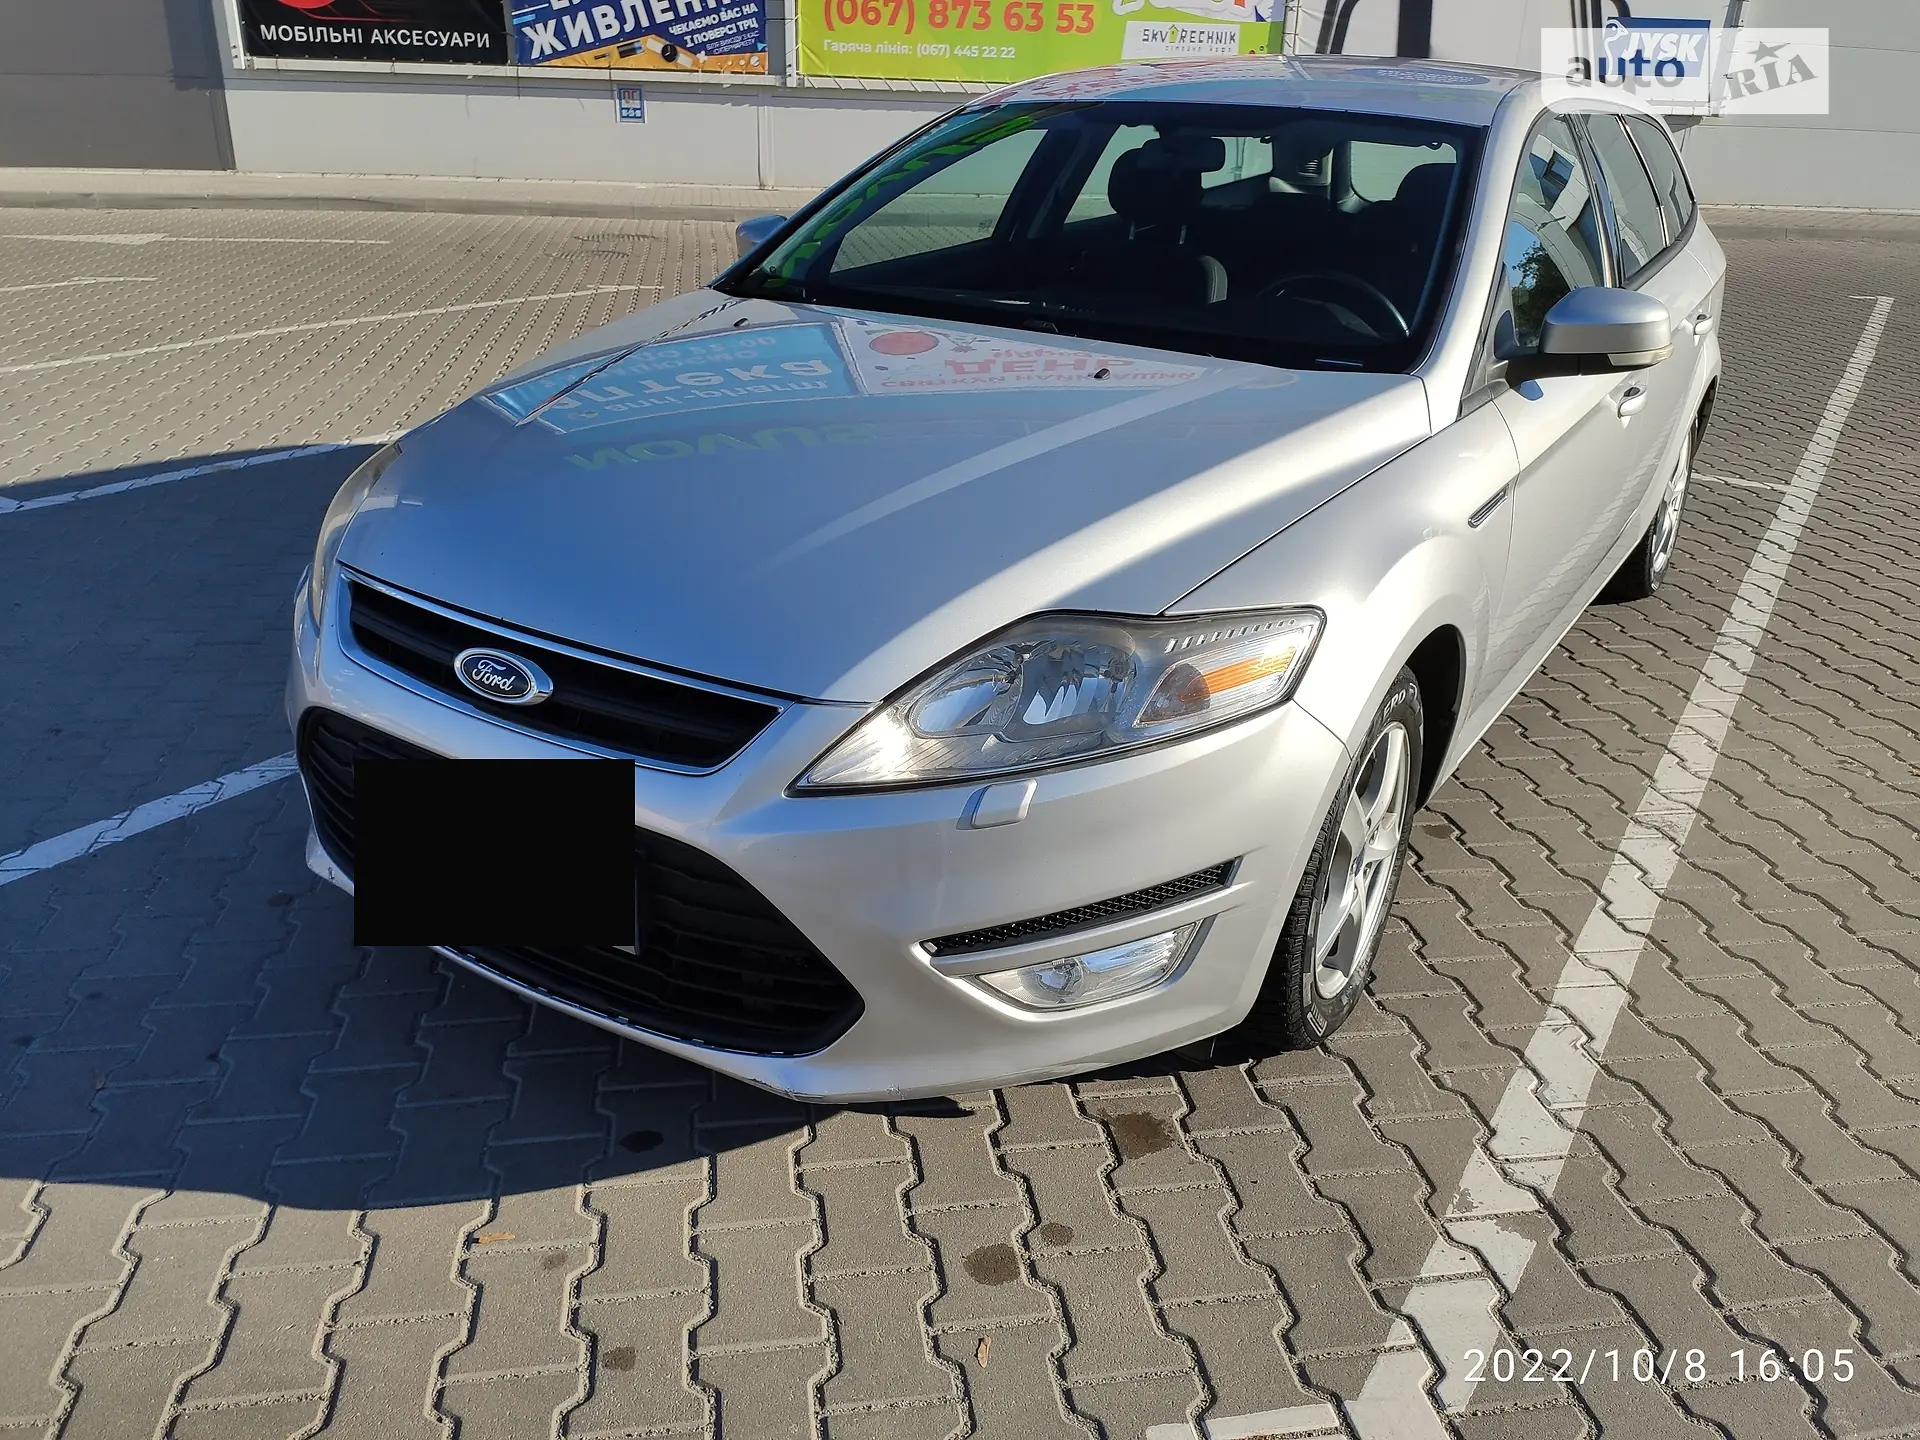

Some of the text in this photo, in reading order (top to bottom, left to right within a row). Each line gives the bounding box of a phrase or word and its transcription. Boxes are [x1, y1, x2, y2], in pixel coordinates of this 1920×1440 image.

[520, 0, 740, 60] ЖИВЛЕН
[668, 2, 759, 36] ЧЕКАЄМО ВАС НА
[693, 24, 738, 45] ПОВЕРСІ
[736, 17, 759, 31] ТРЦ
[824, 0, 1095, 35] (067) 873 63 53
[260, 24, 490, 49] МОБІЛЬНІ АКСЕСУАРИ
[823, 39, 1016, 59] Гаряча лінія: (067) 445 22 22
[1622, 32, 1703, 62] JYSK
[472, 659, 516, 691] Ford
